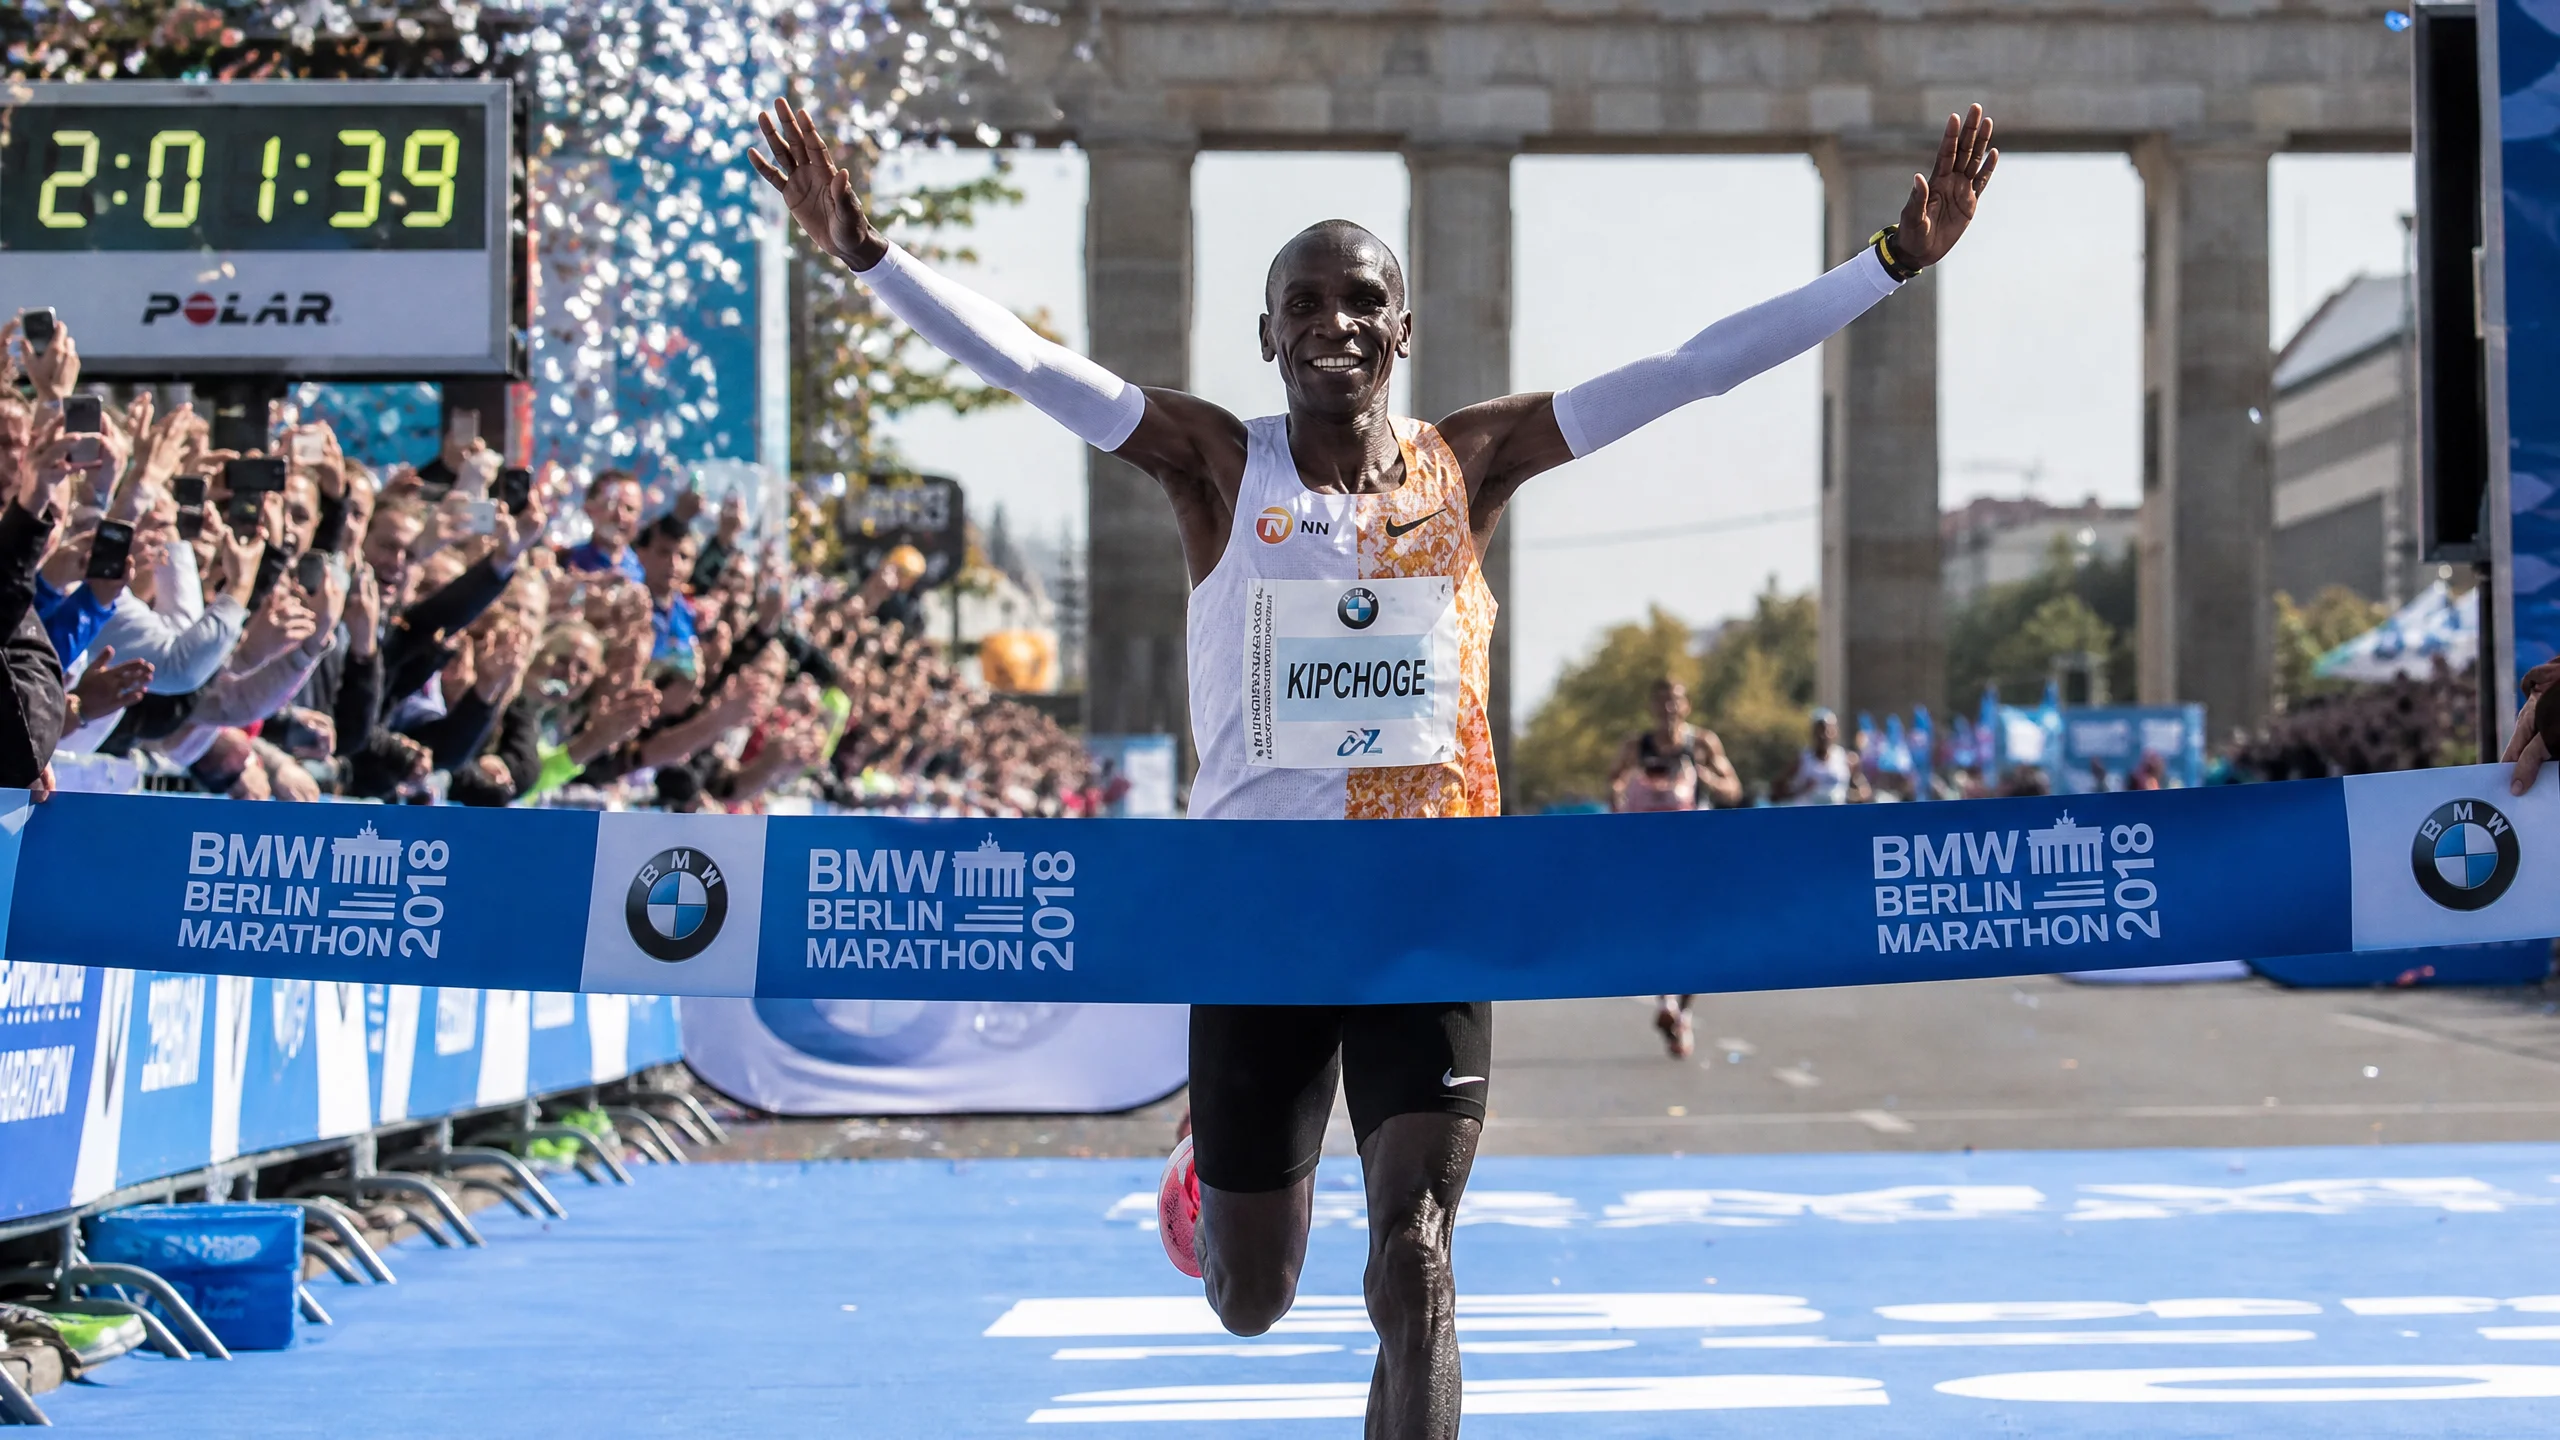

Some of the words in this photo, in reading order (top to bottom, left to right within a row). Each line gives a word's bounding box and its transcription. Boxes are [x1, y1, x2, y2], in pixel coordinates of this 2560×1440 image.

[38, 129, 461, 229] 2:01:39
[141, 292, 335, 326] POLAR
[1300, 520, 1330, 536] NN
[1286, 659, 1427, 699] KIPCHOGE
[2420, 801, 2510, 842] BMW
[188, 831, 326, 880] BMW
[638, 850, 722, 889] BMW
[808, 848, 946, 894] BMW
[1872, 829, 2020, 880] BMW
[183, 880, 321, 917] BERLIN
[398, 839, 451, 959] 2018
[1875, 880, 2023, 917] BERLIN
[2110, 822, 2161, 940] 2018
[807, 898, 943, 932] BERLIN
[1030, 850, 1076, 972] 2018
[177, 918, 393, 957] MARATHON
[806, 937, 1024, 971] MARATHON
[1877, 913, 2110, 955] MARATHON
